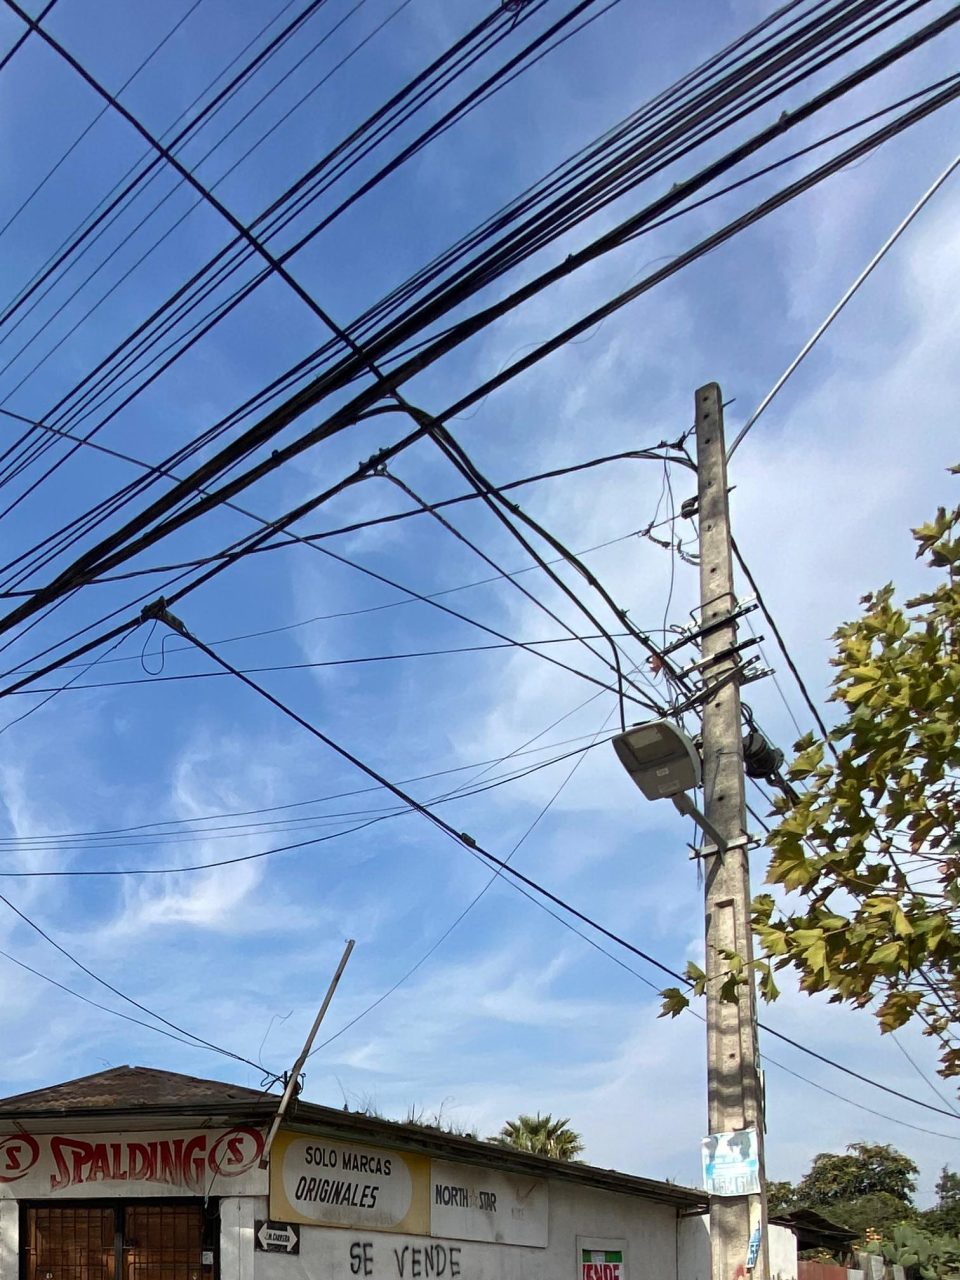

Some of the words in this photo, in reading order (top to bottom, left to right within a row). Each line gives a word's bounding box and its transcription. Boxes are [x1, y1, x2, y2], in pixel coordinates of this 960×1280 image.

[50, 1134, 207, 1194] SPALDING
[305, 1145, 337, 1168] SOLO
[342, 1151, 392, 1176] MARCAS
[295, 1176, 379, 1208] ORIGINALES
[435, 1184, 468, 1208] NORTH
[479, 1191, 497, 1212] STAR
[350, 1242, 373, 1276] SE
[395, 1244, 461, 1278] VENDE
